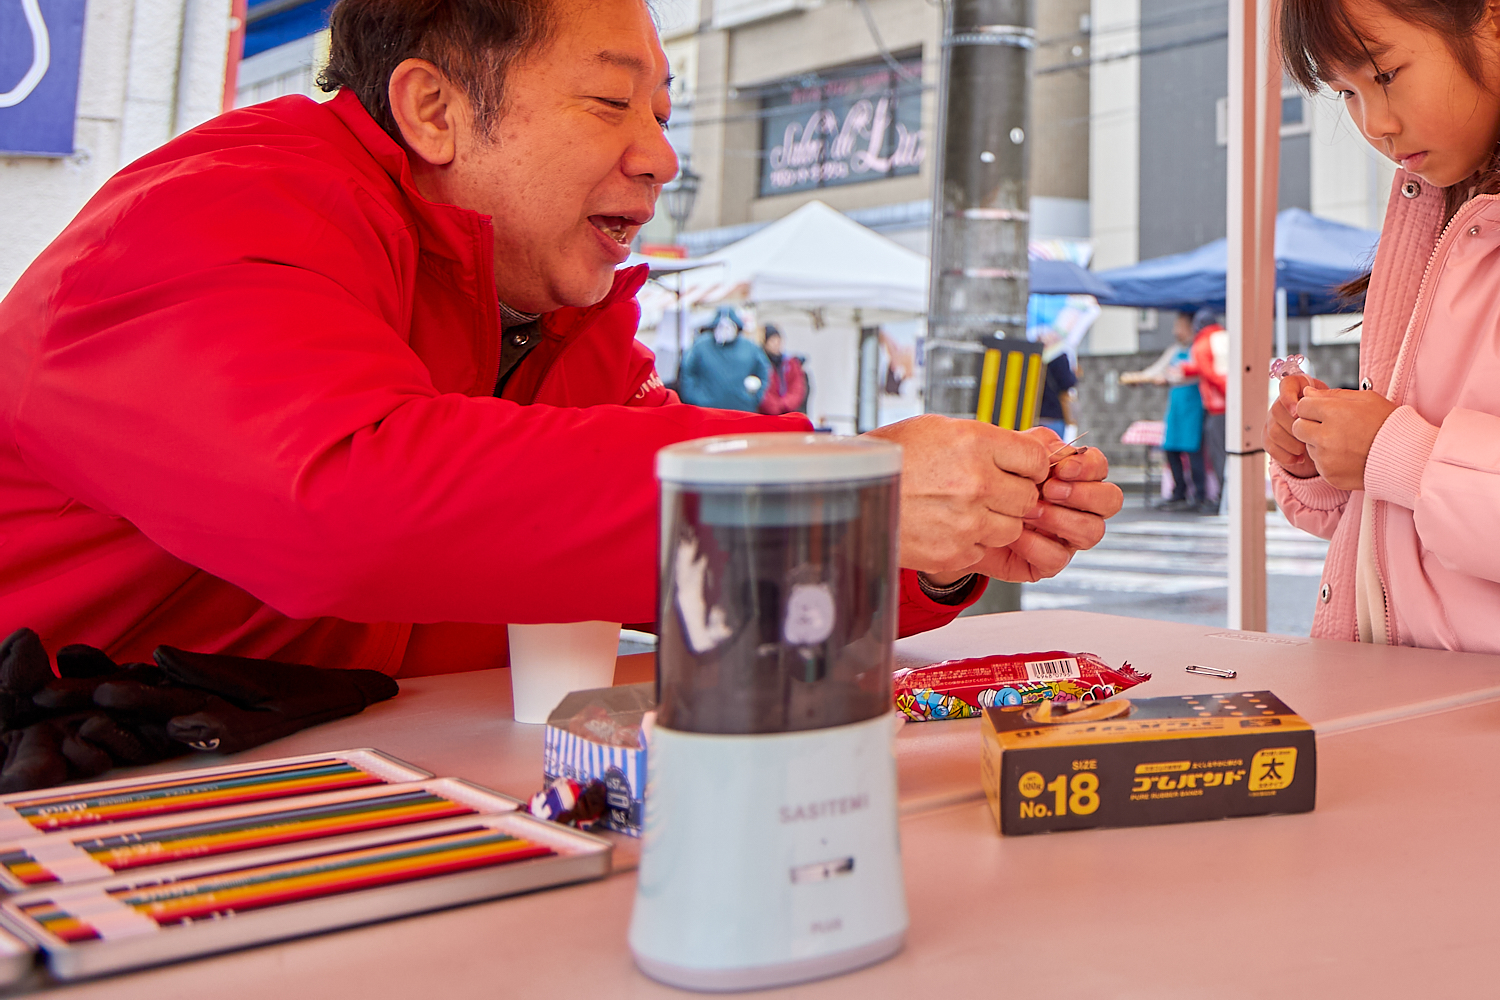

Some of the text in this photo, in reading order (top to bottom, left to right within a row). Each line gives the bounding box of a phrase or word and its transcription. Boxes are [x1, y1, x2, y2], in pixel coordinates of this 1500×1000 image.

[1072, 759, 1097, 770] SIZE
[1260, 758, 1284, 781] 太
[1131, 769, 1246, 792] ゴムバンド
[1129, 789, 1204, 801] PURE RUBBER BANDS
